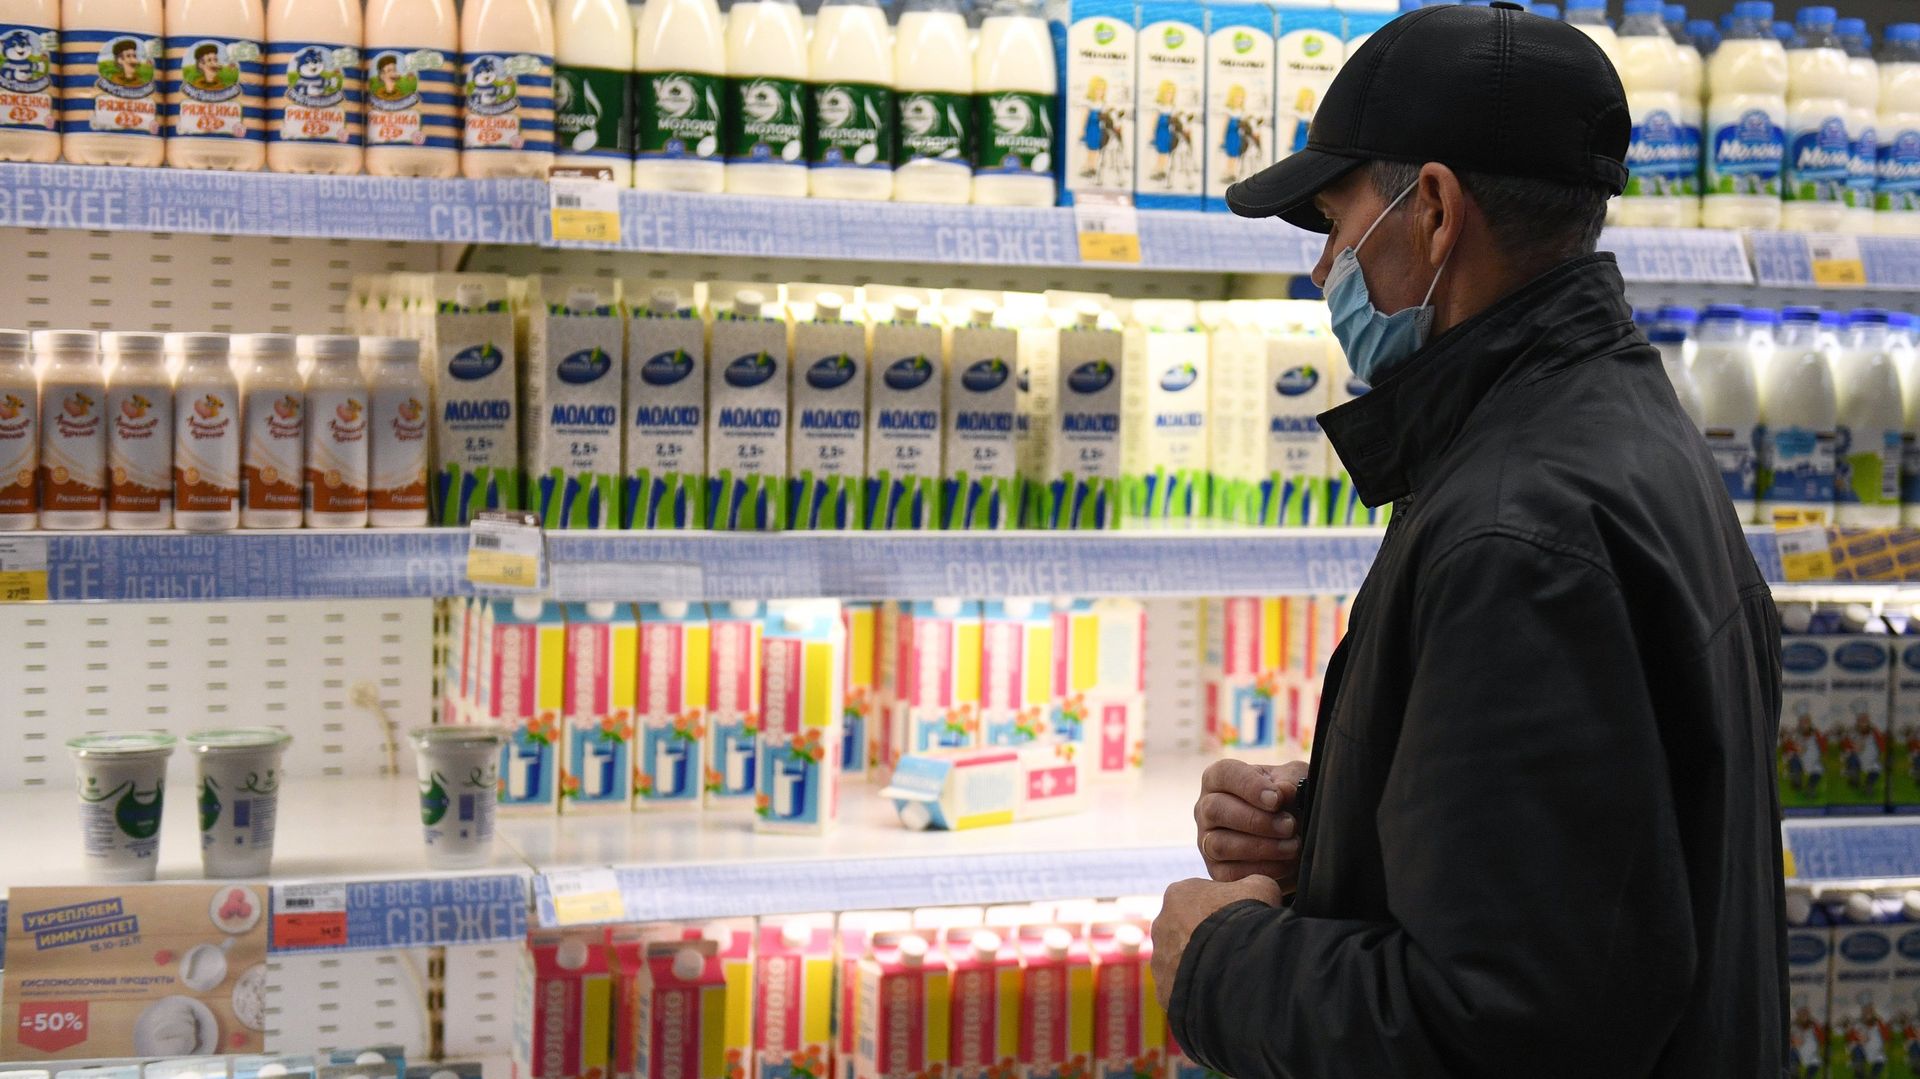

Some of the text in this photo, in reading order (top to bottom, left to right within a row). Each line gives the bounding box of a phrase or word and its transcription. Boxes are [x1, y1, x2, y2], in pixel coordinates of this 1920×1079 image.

[0, 94, 49, 108] ЯЖЕНКА
[98, 99, 155, 113] РЯЖЕНКА
[183, 104, 239, 116] РЯЖЕНКА
[287, 109, 342, 122] РЯЖЕНКА
[658, 118, 716, 132] МОЛОКО
[744, 123, 801, 137] МОЛОКО
[819, 128, 876, 140] МОЛОКО
[995, 136, 1050, 148] МОЛОКО
[40, 168, 123, 189] ВСЕГДА
[146, 171, 240, 191] КАЧЕСТВО
[319, 179, 425, 201] ВЫСОКОЕ
[430, 180, 465, 202] ВСЕ
[475, 180, 490, 202] И
[0, 188, 123, 226] ВЕЖЕЕ
[148, 207, 241, 232] ДЕНЬГИ
[935, 226, 1059, 261] СВЕЖЕЕ
[445, 400, 510, 422] МОЛОКО
[552, 405, 615, 427] МОЛОКО
[636, 406, 699, 427] МОЛОКО
[719, 408, 780, 429] МОЛОКО
[801, 410, 860, 430] МОЛОКО
[878, 410, 936, 430] МОЛОКО
[956, 412, 1012, 432] МОЛОКО
[1062, 413, 1118, 432] МОЛОКО
[122, 537, 216, 556] КАЧЕСТВО
[296, 536, 399, 557] ВЫСОКОЕ
[125, 576, 216, 599] ДЕНЬГИ
[945, 562, 1068, 597] СВЕЖЕЕ
[385, 882, 423, 906] ВСЕ
[430, 880, 444, 904] И
[451, 877, 525, 903] ВСЕГДА
[27, 901, 119, 929] УКРЕПЛЯЕМ
[386, 902, 527, 945] СВЕЖЕЕ
[40, 919, 135, 947] ИММУНИТЕТ
[21, 975, 175, 988] КИСЛОМОЛОЧНЫЕ ПРОДУКТЫ
[767, 958, 785, 1064] МОЛОКО
[21, 1012, 83, 1032] -50%
